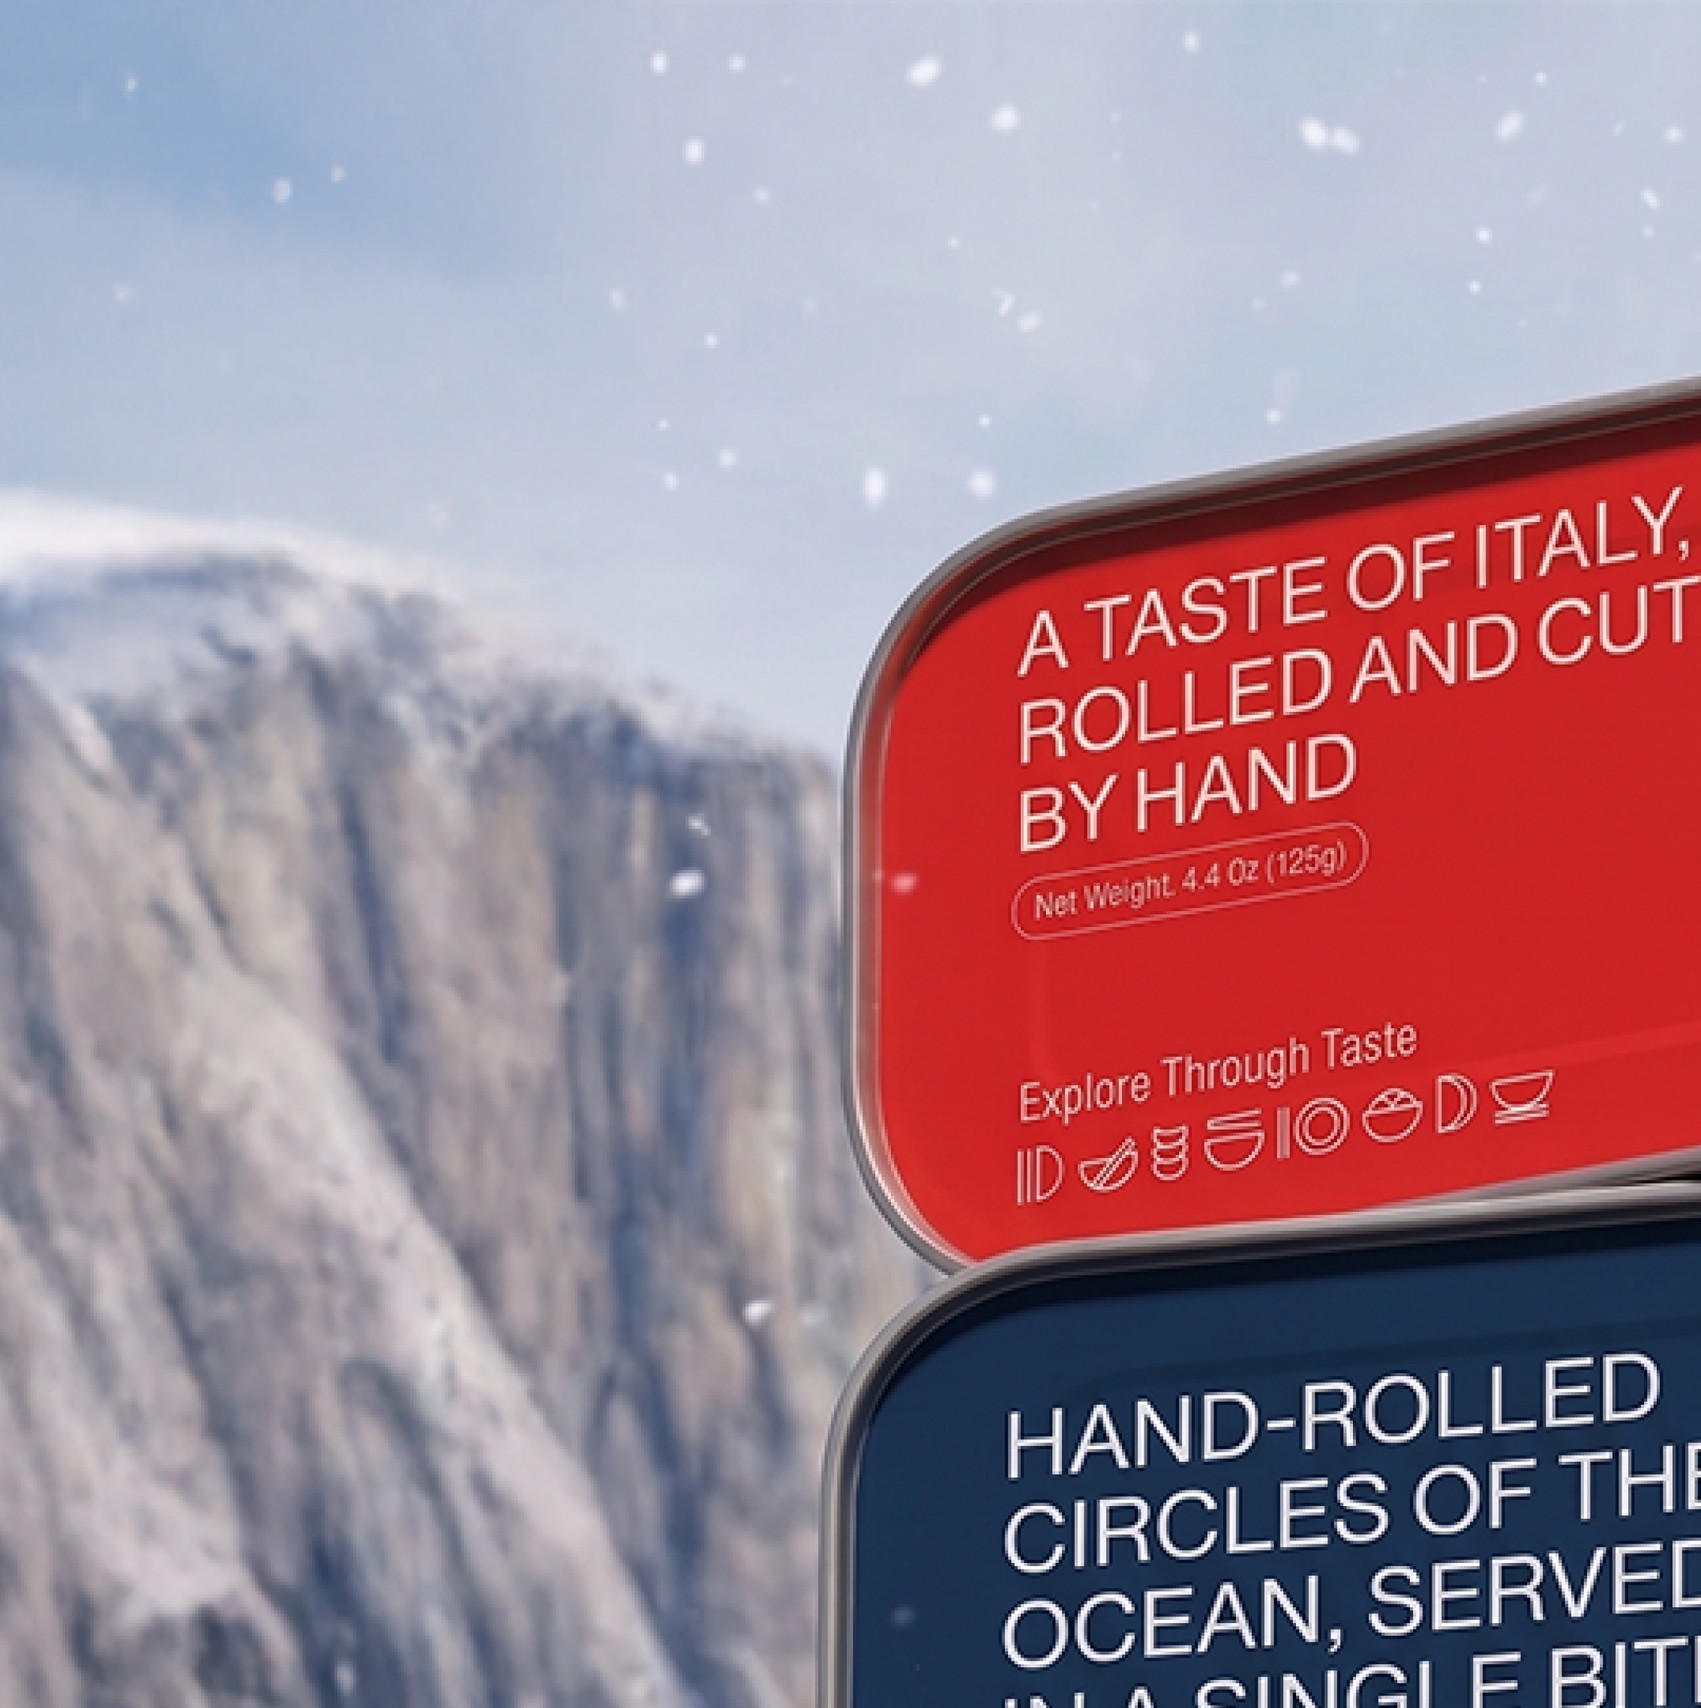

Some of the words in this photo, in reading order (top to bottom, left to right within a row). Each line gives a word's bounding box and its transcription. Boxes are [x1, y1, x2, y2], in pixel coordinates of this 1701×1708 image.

[1018, 611, 1068, 675] A
[1084, 557, 1325, 659] TASTE
[1349, 532, 1454, 608] OF
[1479, 487, 1688, 588] ITALY,
[1021, 649, 1331, 763] ROLLED
[1350, 614, 1517, 702] AND
[1540, 576, 1701, 664] CUT
[1021, 775, 1116, 851] BY
[1138, 734, 1356, 830] HAND
[1033, 890, 1078, 920] Net
[1181, 861, 1220, 892] 4.4
[1267, 840, 1347, 882] (125g)
[1021, 1072, 1150, 1124] Explore
[1160, 1037, 1309, 1096] Through
[1322, 1022, 1417, 1068] Taste
[1008, 1354, 1660, 1478] HAND-ROLLED
[1005, 1474, 1388, 1573] CIRCLES
[1416, 1458, 1536, 1534] OF
[1004, 1575, 1341, 1668] OCEAN,
